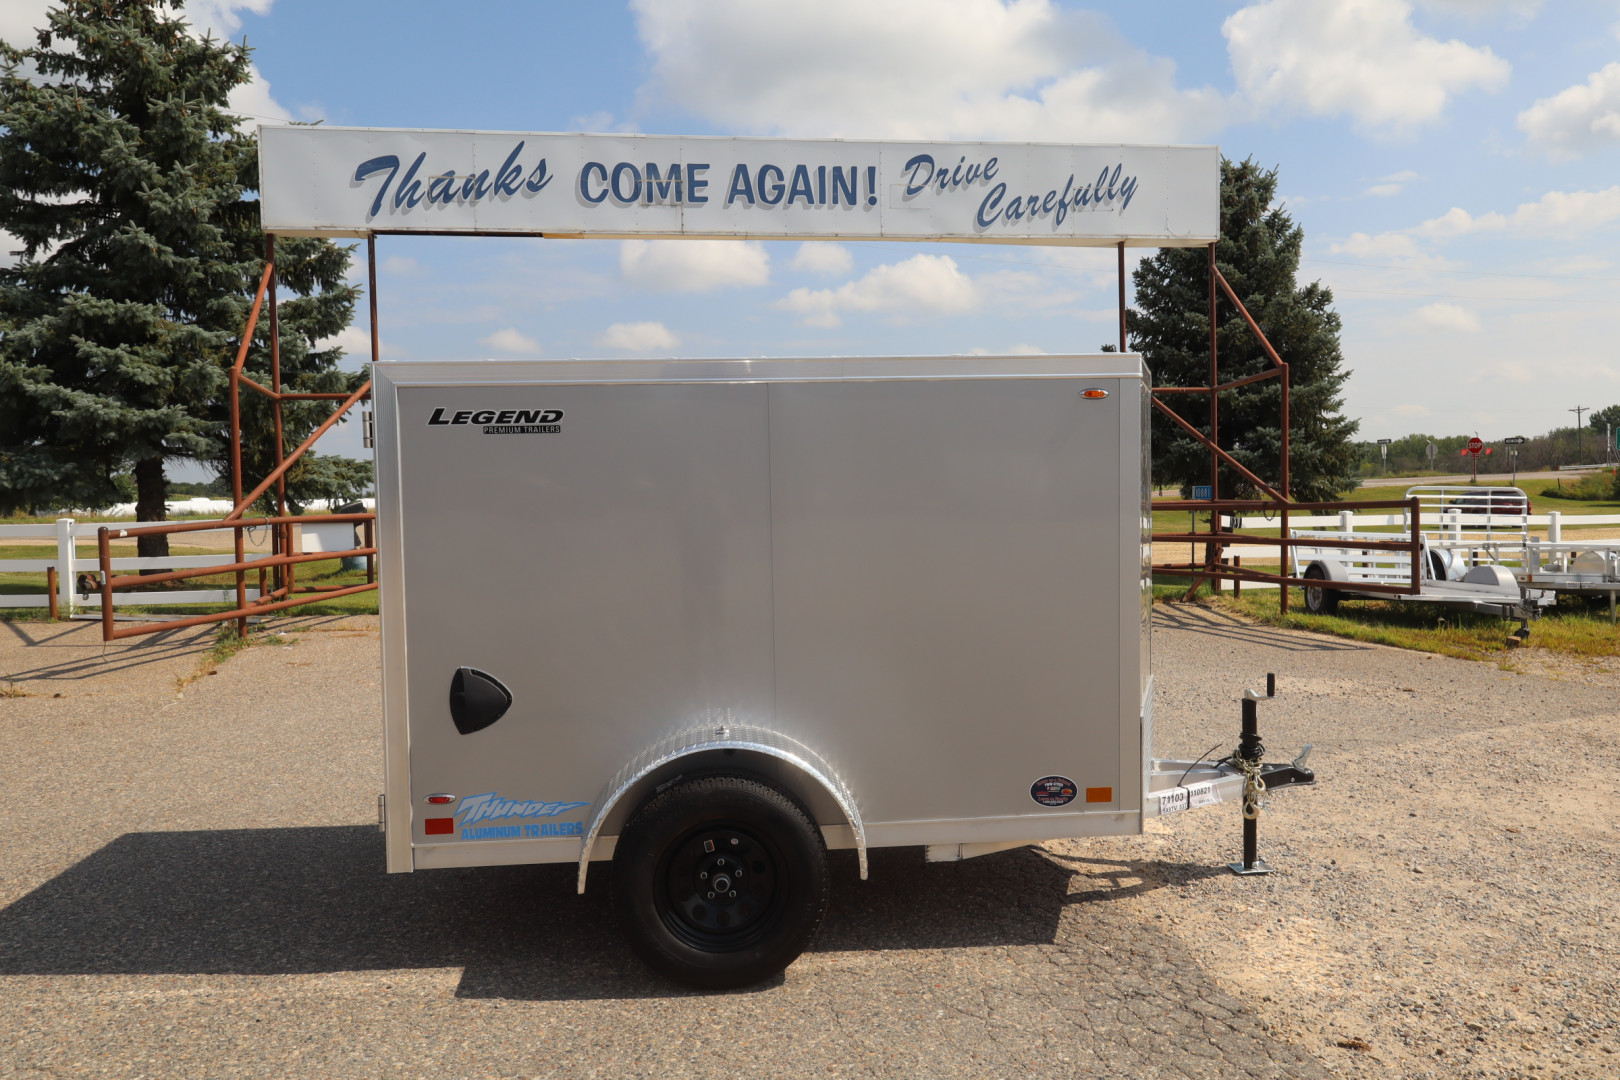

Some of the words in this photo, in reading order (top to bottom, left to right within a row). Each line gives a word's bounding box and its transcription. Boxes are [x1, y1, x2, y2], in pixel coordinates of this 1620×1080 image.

[354, 140, 553, 218] Thanks
[579, 161, 710, 204] COME
[727, 163, 878, 207] AGAIN!
[904, 153, 999, 196] Drive
[976, 163, 1138, 228] Carefully
[428, 407, 564, 425] LEGEND
[523, 425, 560, 433] TRAILERS
[1468, 442, 1482, 450] STOP
[1162, 793, 1184, 805] 71103
[461, 825, 521, 840] ALUMINUM
[524, 822, 584, 837] TRAILERS
